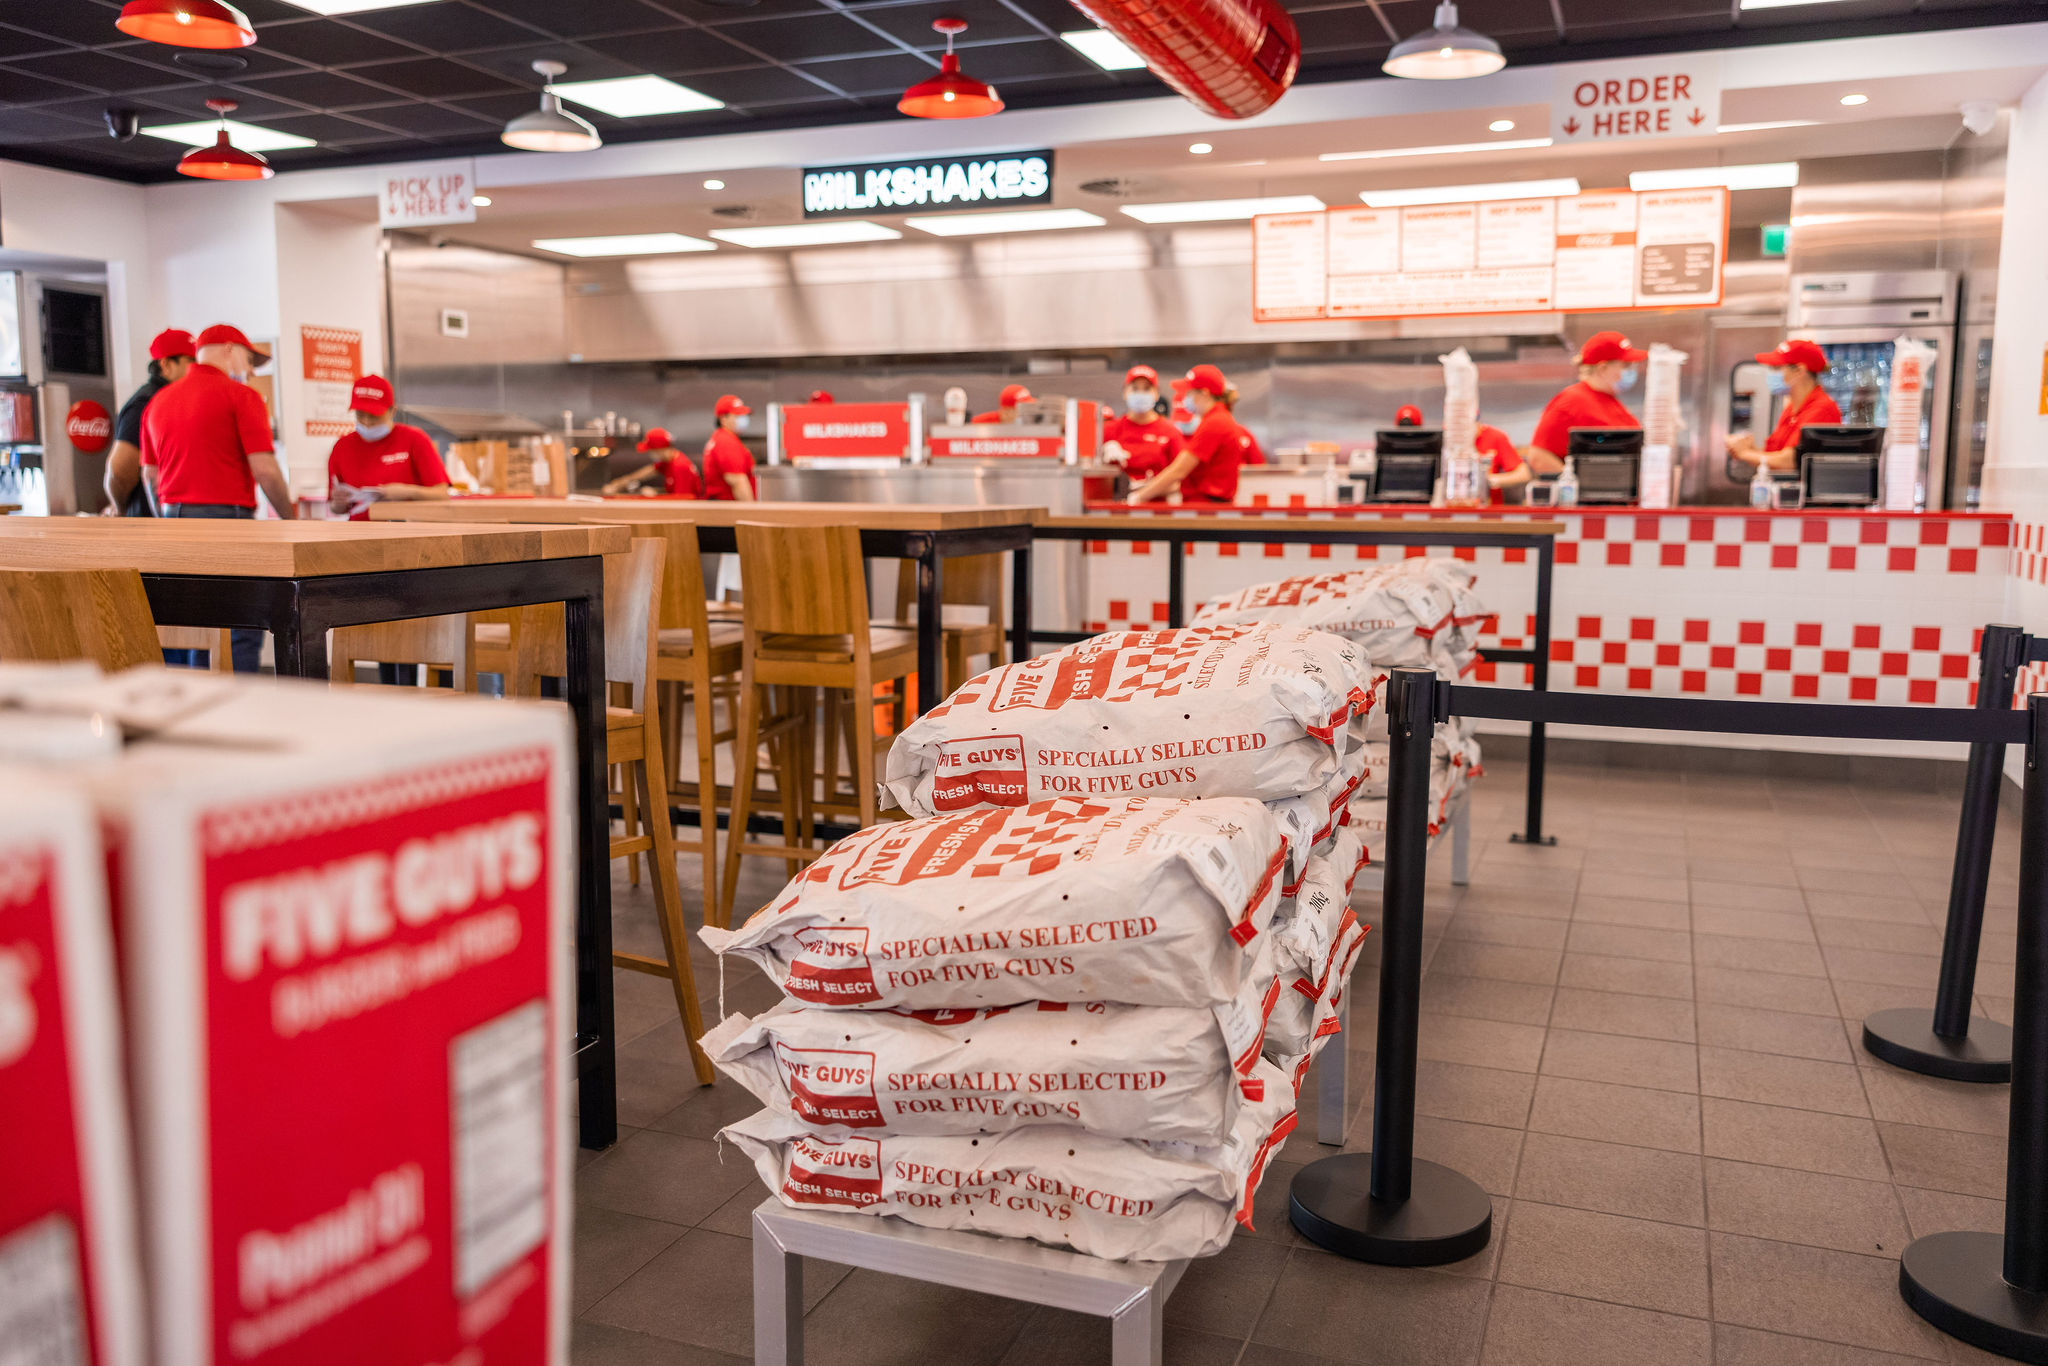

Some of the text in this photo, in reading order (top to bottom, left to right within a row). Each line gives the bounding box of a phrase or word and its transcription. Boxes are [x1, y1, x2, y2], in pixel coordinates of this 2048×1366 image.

[1574, 75, 1692, 108] ORDER
[1593, 108, 1671, 137] HERE
[387, 173, 465, 200] PICK UP
[804, 157, 1050, 212] MILKSHAKES
[404, 196, 449, 217] HERE
[1008, 673, 1044, 706] FIVE
[1038, 732, 1267, 767] SPECIALLY SELECTED
[933, 782, 1025, 800] FRESH SELECT
[1040, 766, 1197, 794] FOR FIVE GUYS
[858, 836, 912, 881] FIVE
[918, 832, 972, 876] FRESH
[222, 811, 543, 981] FIVE GUYS
[880, 916, 1158, 961] SPECIALLY SELECTED
[822, 981, 872, 994] SELECT
[888, 956, 1075, 988] FOR FIVE GUYS
[888, 1070, 1167, 1093] SPECIALLY SELECTED
[821, 1108, 878, 1120] SELECT
[895, 1099, 945, 1115] FOR
[953, 1097, 1008, 1116] FIVE
[825, 1187, 880, 1204] SELECT
[896, 1191, 944, 1208] FOR
[1006, 1196, 1072, 1222] GUYS
[1026, 1174, 1154, 1218] SELECTED
